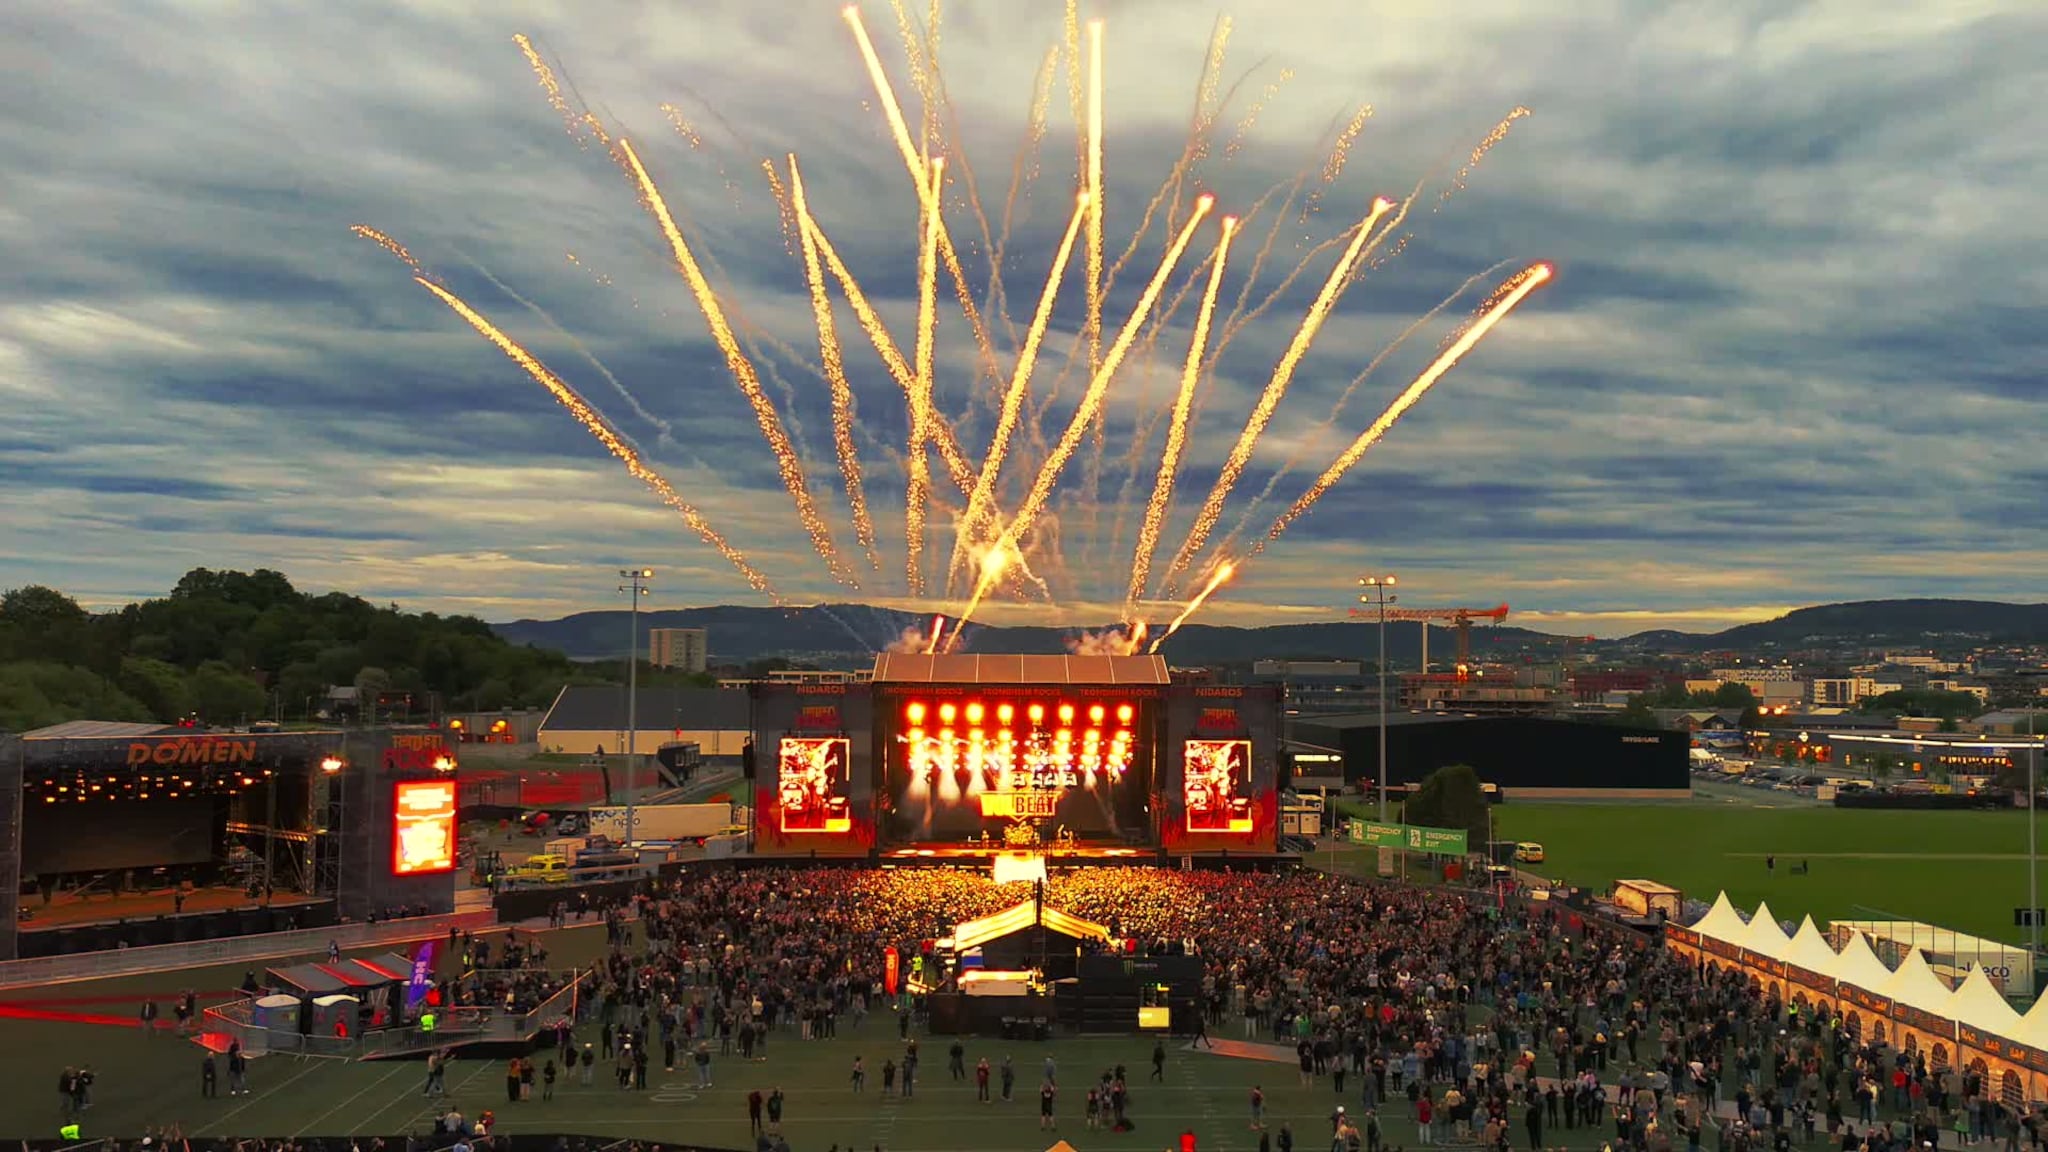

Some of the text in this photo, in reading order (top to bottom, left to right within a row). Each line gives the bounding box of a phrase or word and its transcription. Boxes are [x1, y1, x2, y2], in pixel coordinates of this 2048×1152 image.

[797, 685, 845, 694] NIDAROS
[1195, 687, 1243, 697] NIDAROS
[127, 740, 256, 764] DOMEN
[1367, 825, 1401, 835] EMERGENCY
[1425, 831, 1463, 842] EMERGENCY
[1961, 1028, 2026, 1061] BAR BAR BAR
